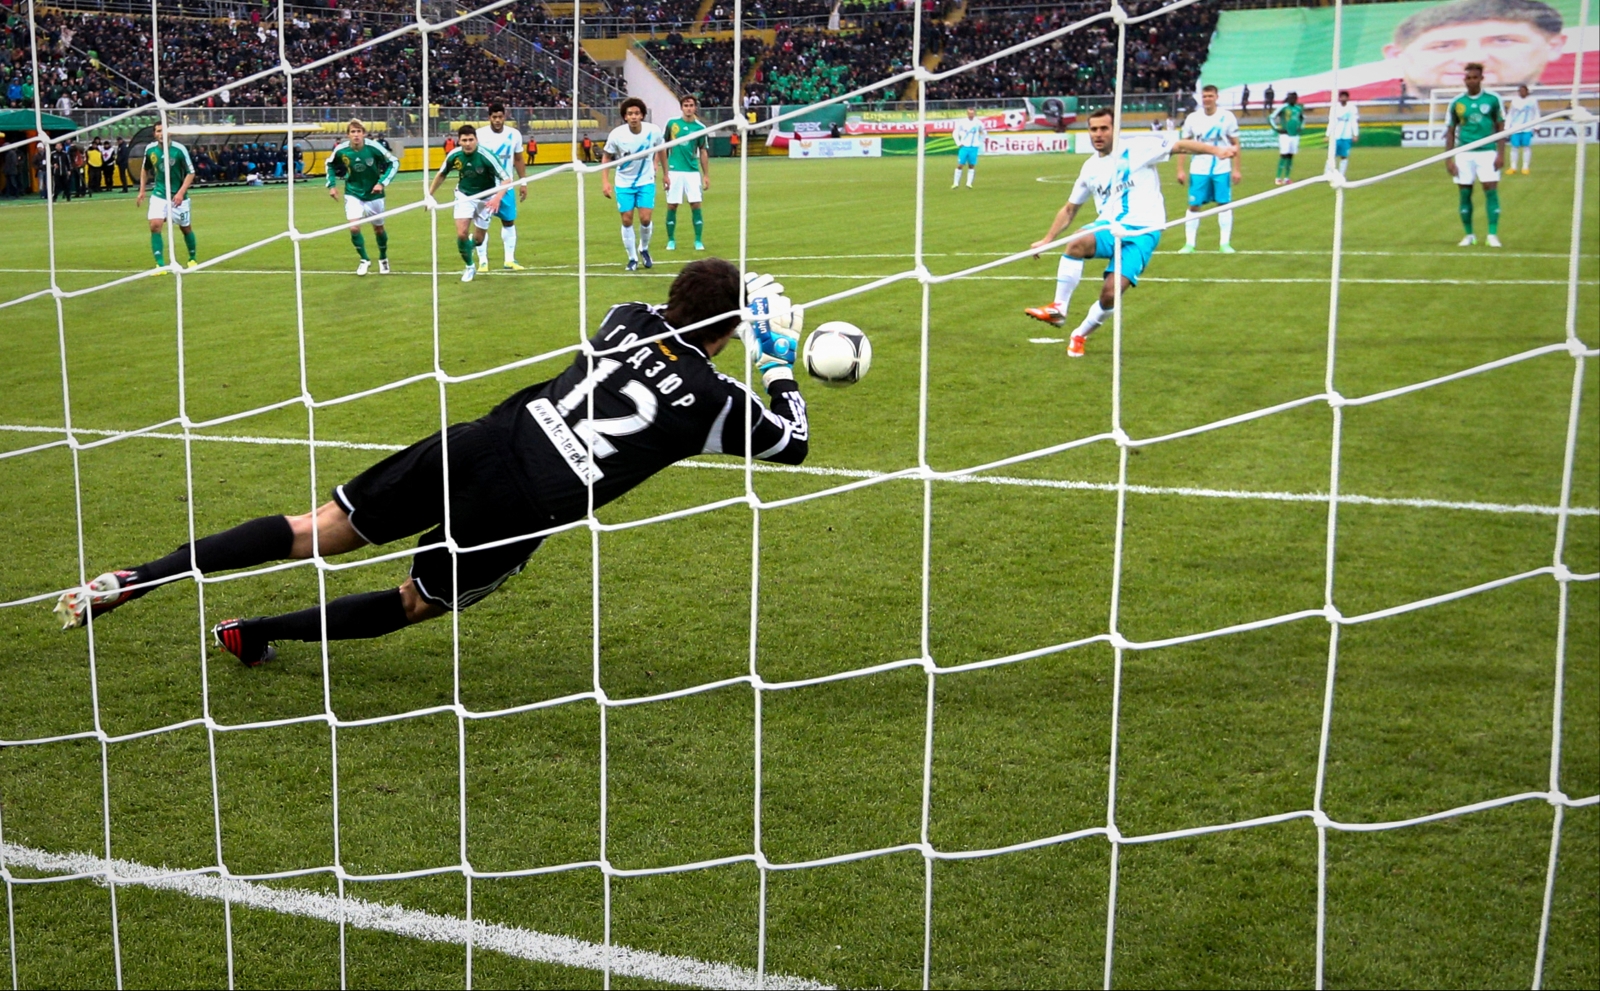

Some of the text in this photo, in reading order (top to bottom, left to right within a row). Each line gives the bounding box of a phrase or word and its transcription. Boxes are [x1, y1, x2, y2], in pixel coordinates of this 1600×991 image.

[984, 137, 1068, 152] fc-terek.ru
[1537, 126, 1592, 138] ОГАЗ
[179, 211, 188, 221] 87
[756, 299, 767, 334] uhlport
[604, 324, 696, 407] ГОДЗЮР
[556, 357, 658, 459] 12
